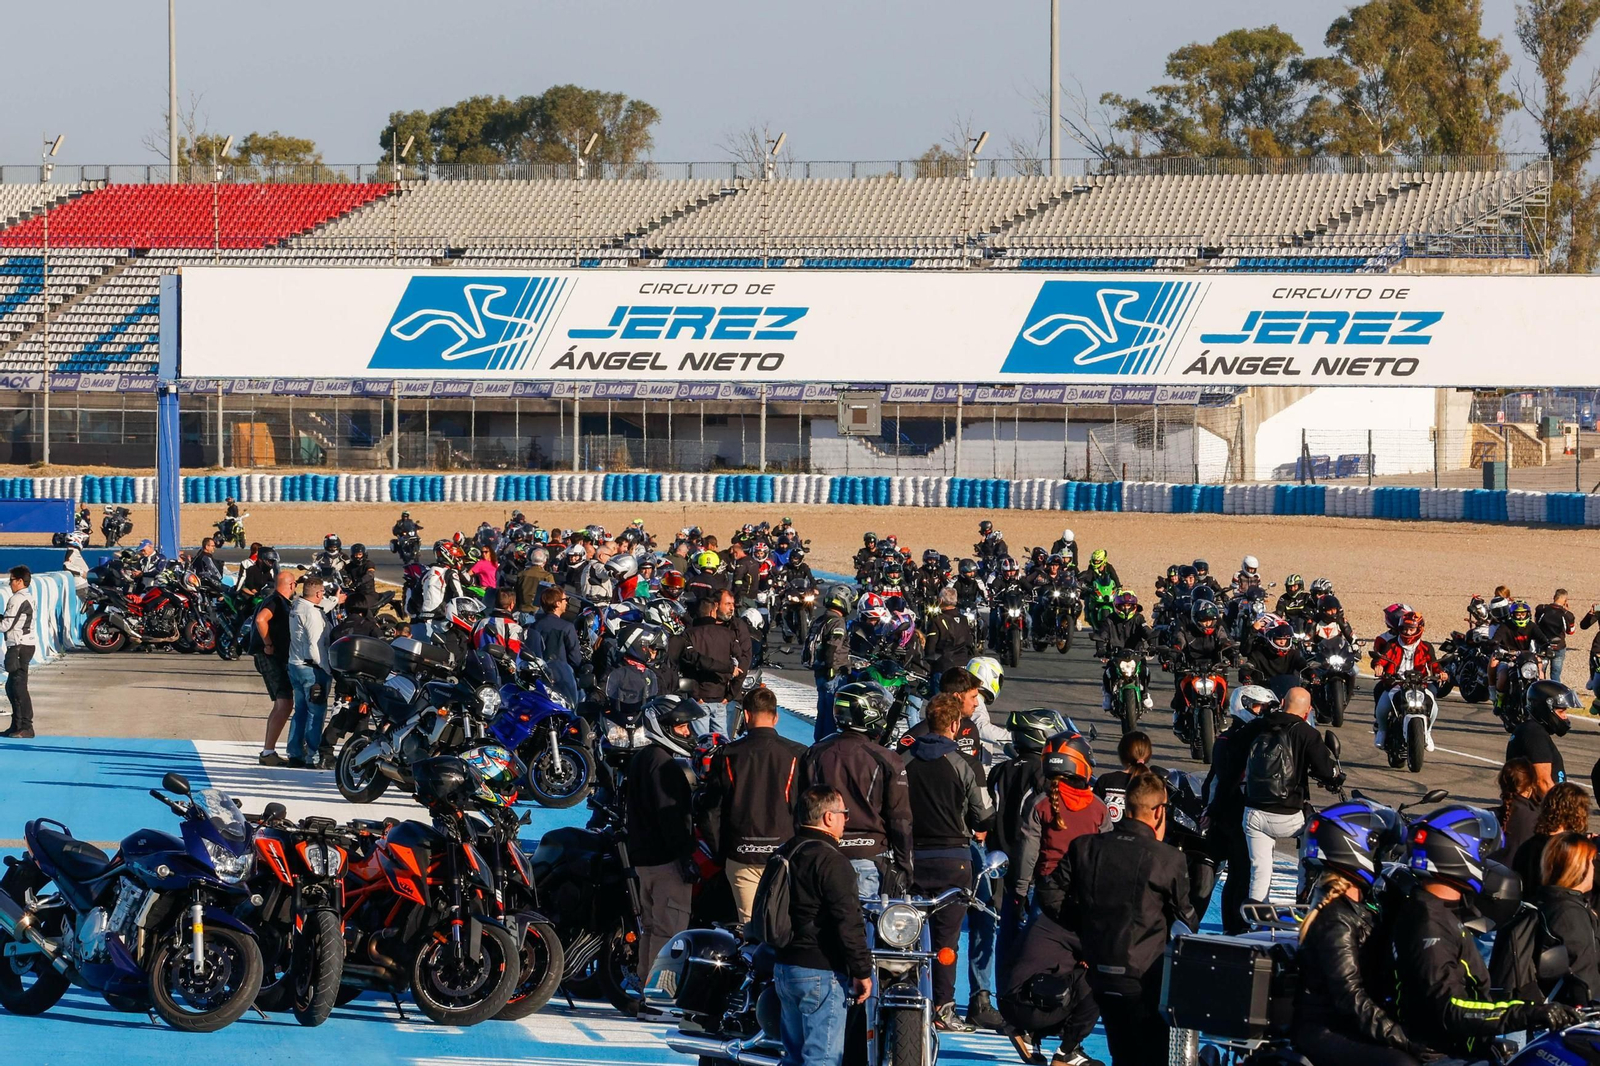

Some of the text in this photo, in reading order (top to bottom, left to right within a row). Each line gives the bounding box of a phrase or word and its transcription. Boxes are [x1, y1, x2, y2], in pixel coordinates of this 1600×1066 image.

[638, 282, 776, 295] CIRCUITO DE
[1272, 287, 1410, 300] CIRCUITO DE
[567, 306, 810, 340] JEREZ
[1200, 311, 1445, 345] JEREZ
[549, 344, 785, 371] ÁNGEL NIETO
[1182, 349, 1420, 377] ÁNGEL NIETO
[52, 378, 79, 388] MAPEI
[90, 378, 116, 388] MAPEI
[129, 379, 156, 389] MAPEI
[246, 380, 271, 390] MAPEI
[284, 381, 312, 391] MAPEI
[325, 382, 350, 391] MAPEI
[363, 382, 391, 392] MAPEI
[404, 383, 430, 392] MAPEI
[443, 383, 471, 393] MAPEI
[485, 383, 511, 393] MAPEI
[524, 384, 552, 394] MAPEI
[606, 385, 634, 395] MAPEI
[648, 385, 675, 395] MAPEI
[690, 386, 718, 396] MAPEI
[732, 386, 758, 396] MAPEI
[774, 387, 802, 397] MAPEI
[903, 388, 930, 398] MAPEI
[991, 388, 1018, 398] MAPEI
[1034, 389, 1063, 399] MAPEI
[1079, 390, 1107, 400] MAPEI
[1123, 390, 1153, 400] MAPEI
[1169, 390, 1198, 400] MAPEI
[736, 843, 780, 854] alpinest
[1535, 1048, 1573, 1066] SUZU
